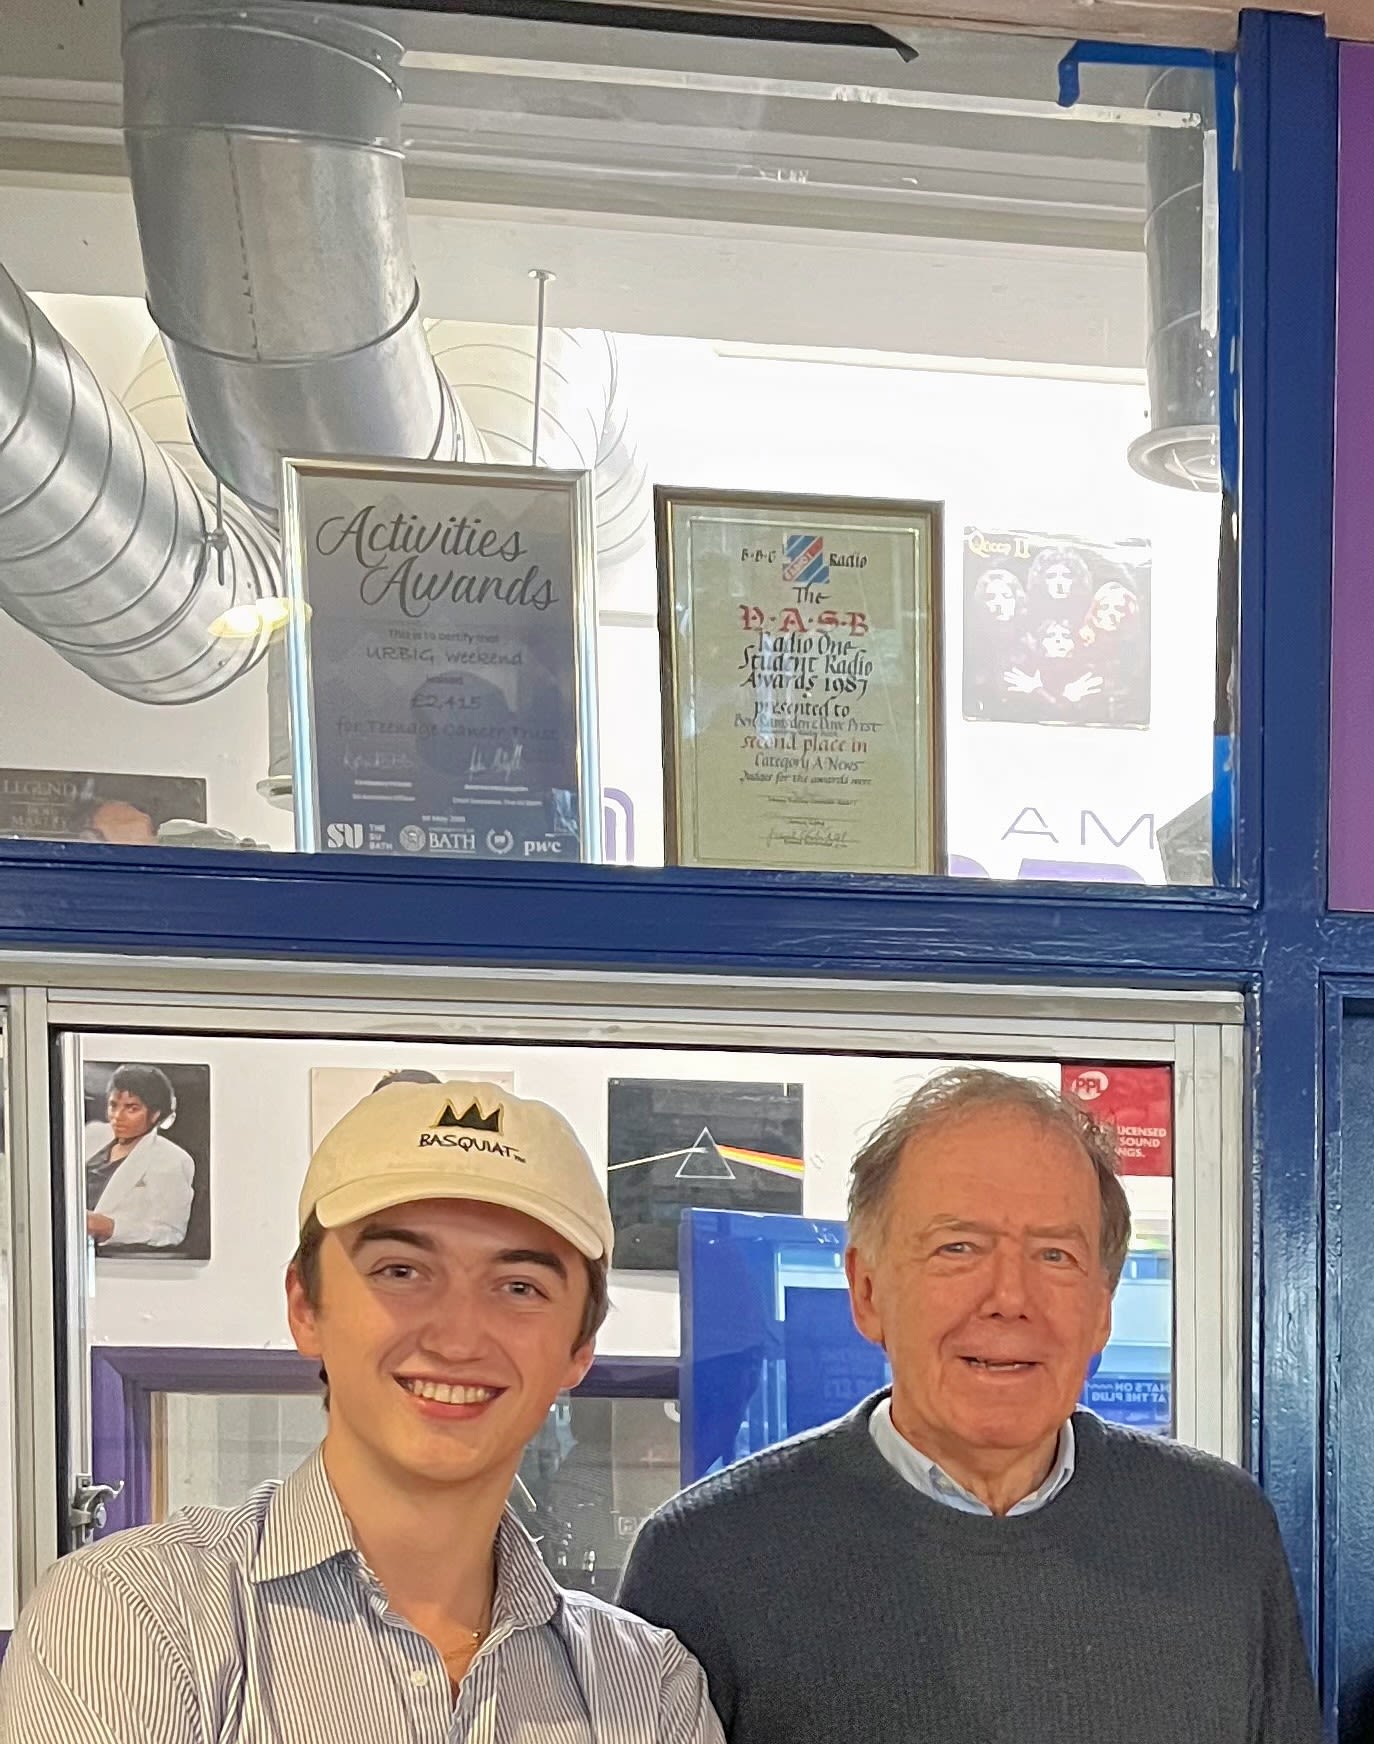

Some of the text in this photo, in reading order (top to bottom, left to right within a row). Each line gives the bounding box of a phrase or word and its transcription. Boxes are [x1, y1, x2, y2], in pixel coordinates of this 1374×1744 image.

[316, 505, 527, 569] Activities
[360, 556, 559, 618] Awards
[792, 582, 832, 604] The
[818, 630, 858, 655] One
[825, 649, 873, 676] Radio
[825, 674, 868, 701] 1987
[834, 705, 849, 718] to
[327, 823, 364, 849] SU
[429, 833, 476, 849] BATH
[1000, 806, 1155, 851] AM
[524, 840, 561, 856] pwc
[418, 1133, 520, 1158] BASQUIAT
[1119, 1136, 1160, 1148] SOUND
